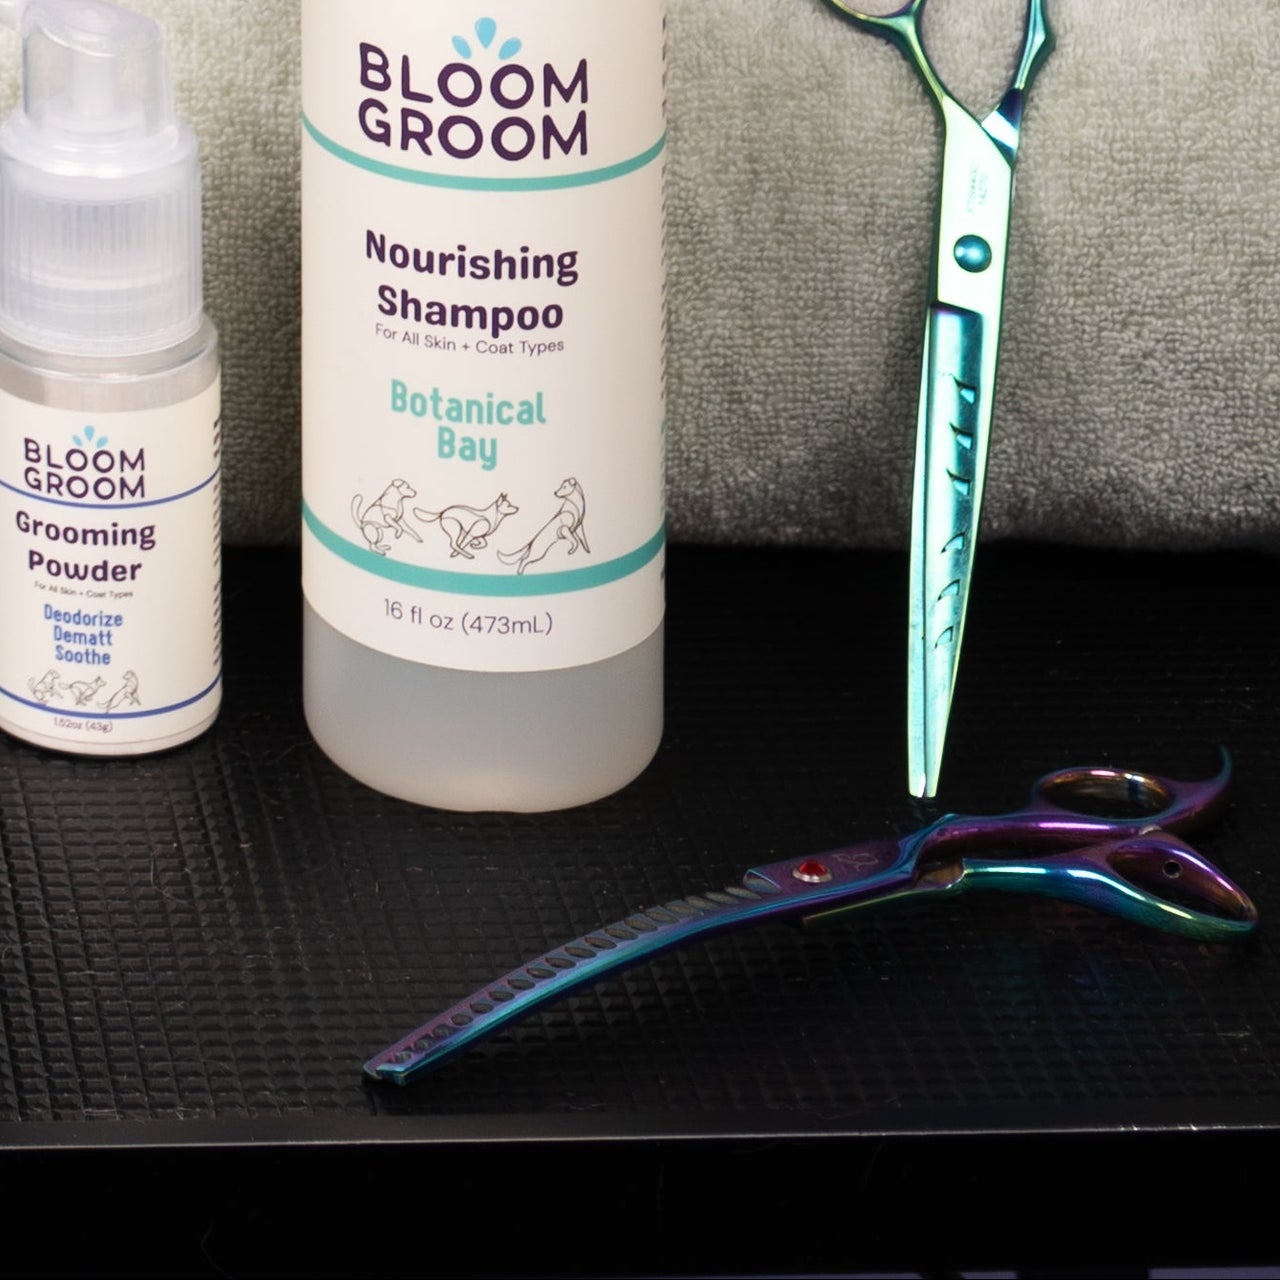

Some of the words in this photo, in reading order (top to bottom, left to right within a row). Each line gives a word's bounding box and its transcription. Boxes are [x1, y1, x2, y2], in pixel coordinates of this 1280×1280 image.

[359, 42, 588, 109] BLOOM
[358, 98, 588, 161] GROOM
[366, 229, 579, 287] Nourishing
[377, 284, 563, 338] Shampoo
[376, 323, 397, 340] For
[402, 331, 420, 345] All
[424, 335, 456, 351] Skin
[462, 343, 471, 351] +
[476, 341, 513, 354] Coat
[519, 340, 564, 357] Types
[391, 378, 546, 426] Botanical
[24, 437, 145, 473] BLOOM
[437, 426, 498, 471] Bay
[24, 466, 145, 500] GROOM
[16, 510, 156, 551] Grooming
[28, 549, 142, 582] Powder
[109, 590, 134, 600] Types
[44, 603, 123, 627] Deodorize
[384, 597, 403, 620] 16
[410, 605, 423, 623] fl
[429, 615, 454, 630] oz
[461, 611, 553, 636] (473mL)
[53, 625, 113, 647] Dematt
[55, 644, 111, 666] Soothe
